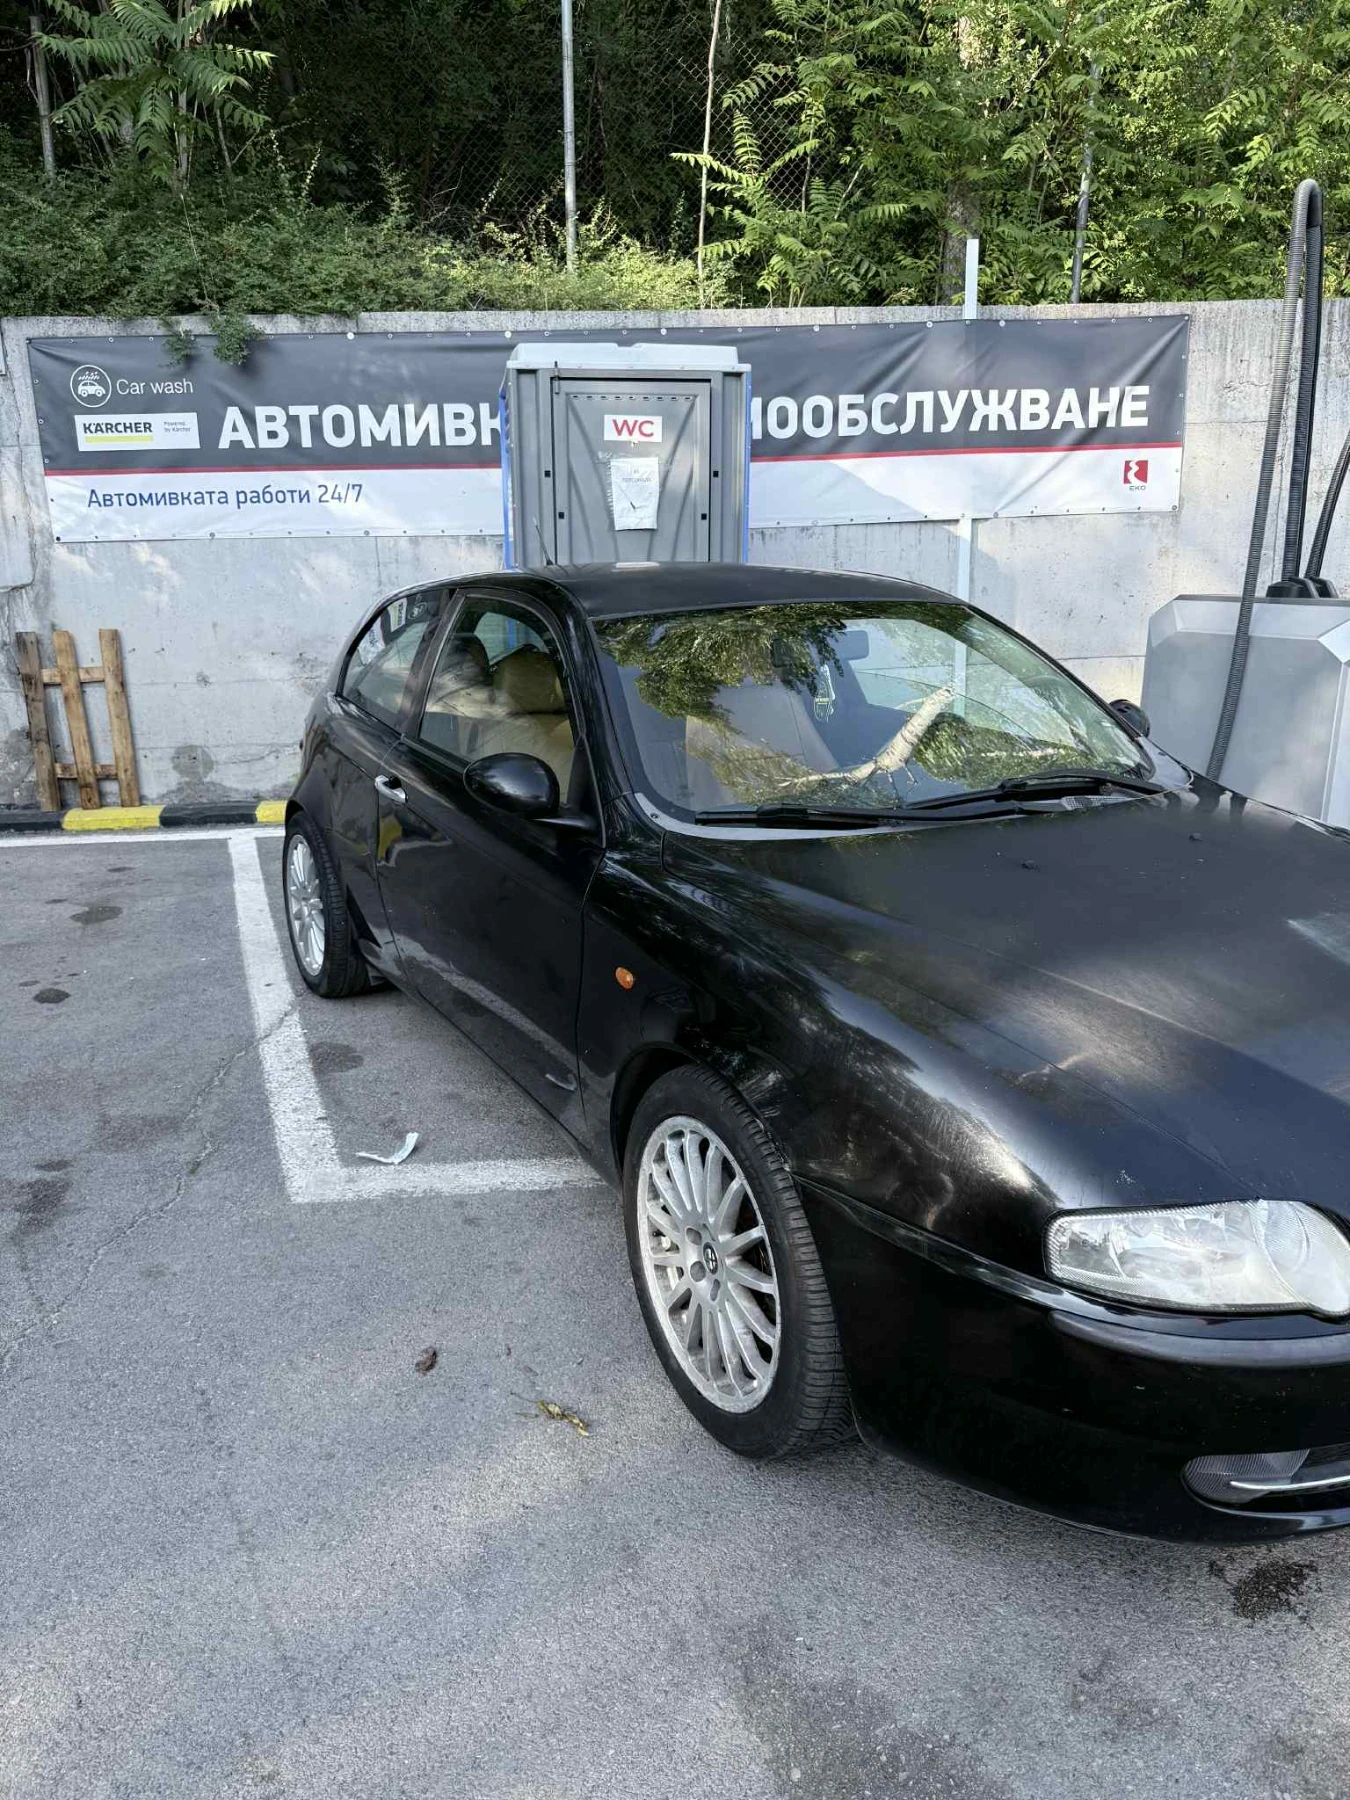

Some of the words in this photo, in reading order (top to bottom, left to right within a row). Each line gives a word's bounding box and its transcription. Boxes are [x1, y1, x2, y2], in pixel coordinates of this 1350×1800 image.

[116, 378, 146, 395] Car
[149, 378, 194, 395] wash
[750, 385, 1150, 439] ООБСЛУЖВАНЕ
[82, 421, 153, 434] KÄRCHER
[612, 419, 654, 438] WC
[87, 488, 229, 508] Автомивката
[235, 484, 311, 509] работи
[317, 482, 363, 504] 24/7
